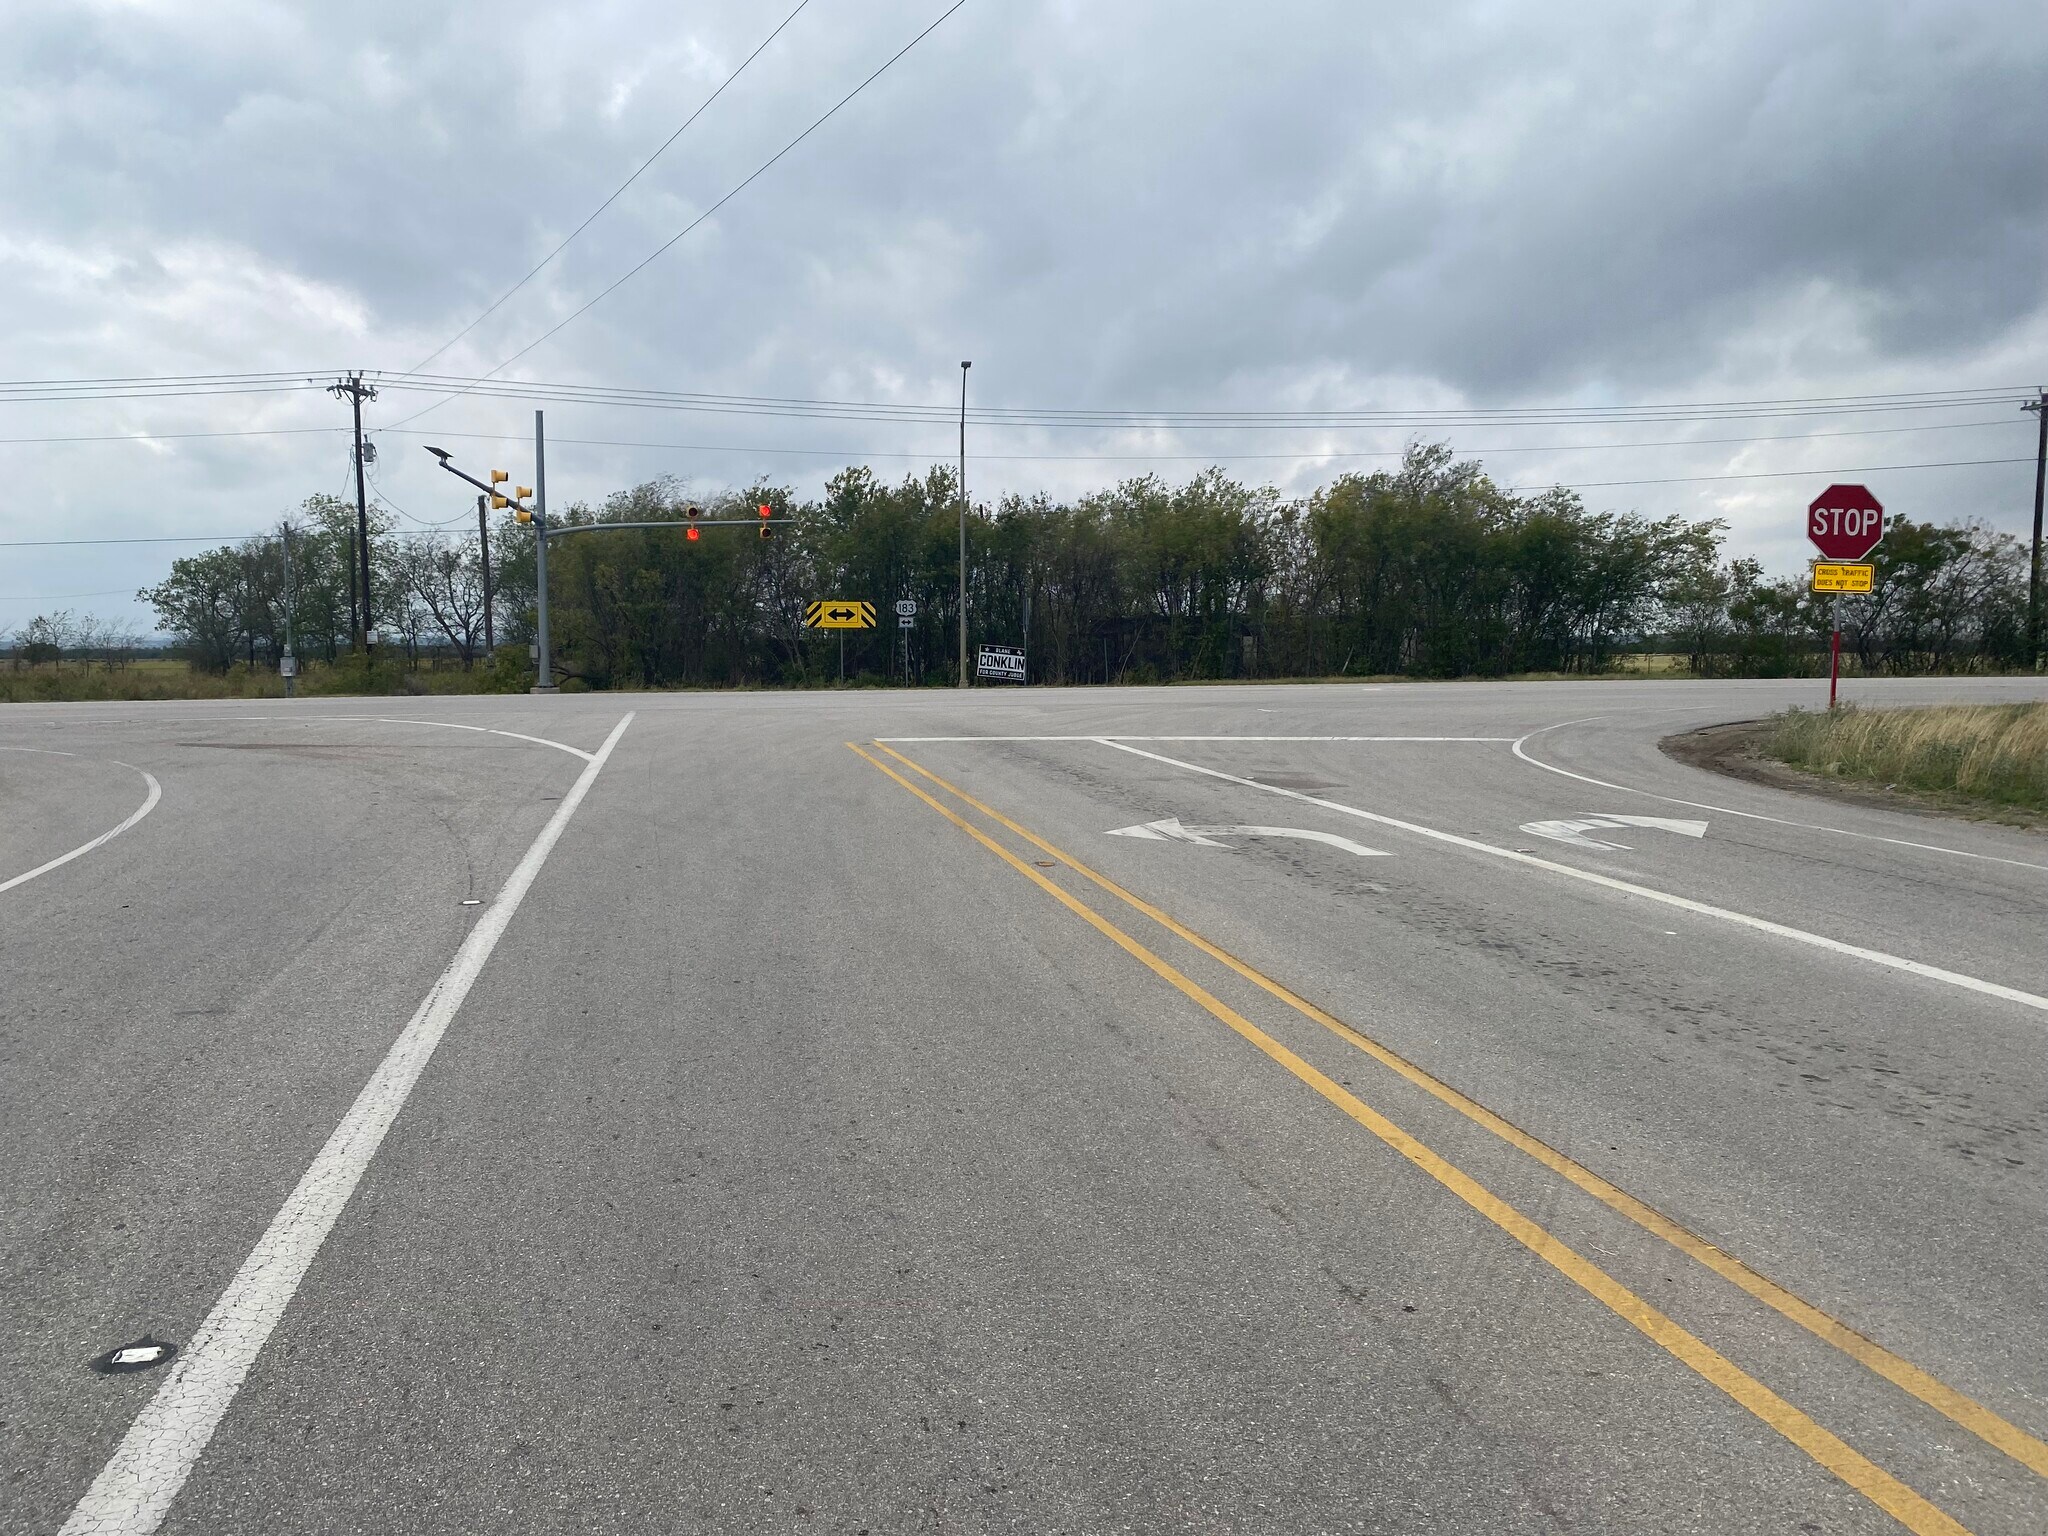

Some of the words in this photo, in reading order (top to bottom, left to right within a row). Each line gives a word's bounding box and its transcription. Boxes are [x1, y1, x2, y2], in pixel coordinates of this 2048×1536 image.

[1813, 508, 1878, 536] STOP
[1818, 568, 1838, 576] CROSS
[1842, 569, 1869, 577] TRAFFIC
[1852, 580, 1869, 588] STOP
[899, 603, 914, 613] 183
[980, 654, 1025, 671] CONKLIN
